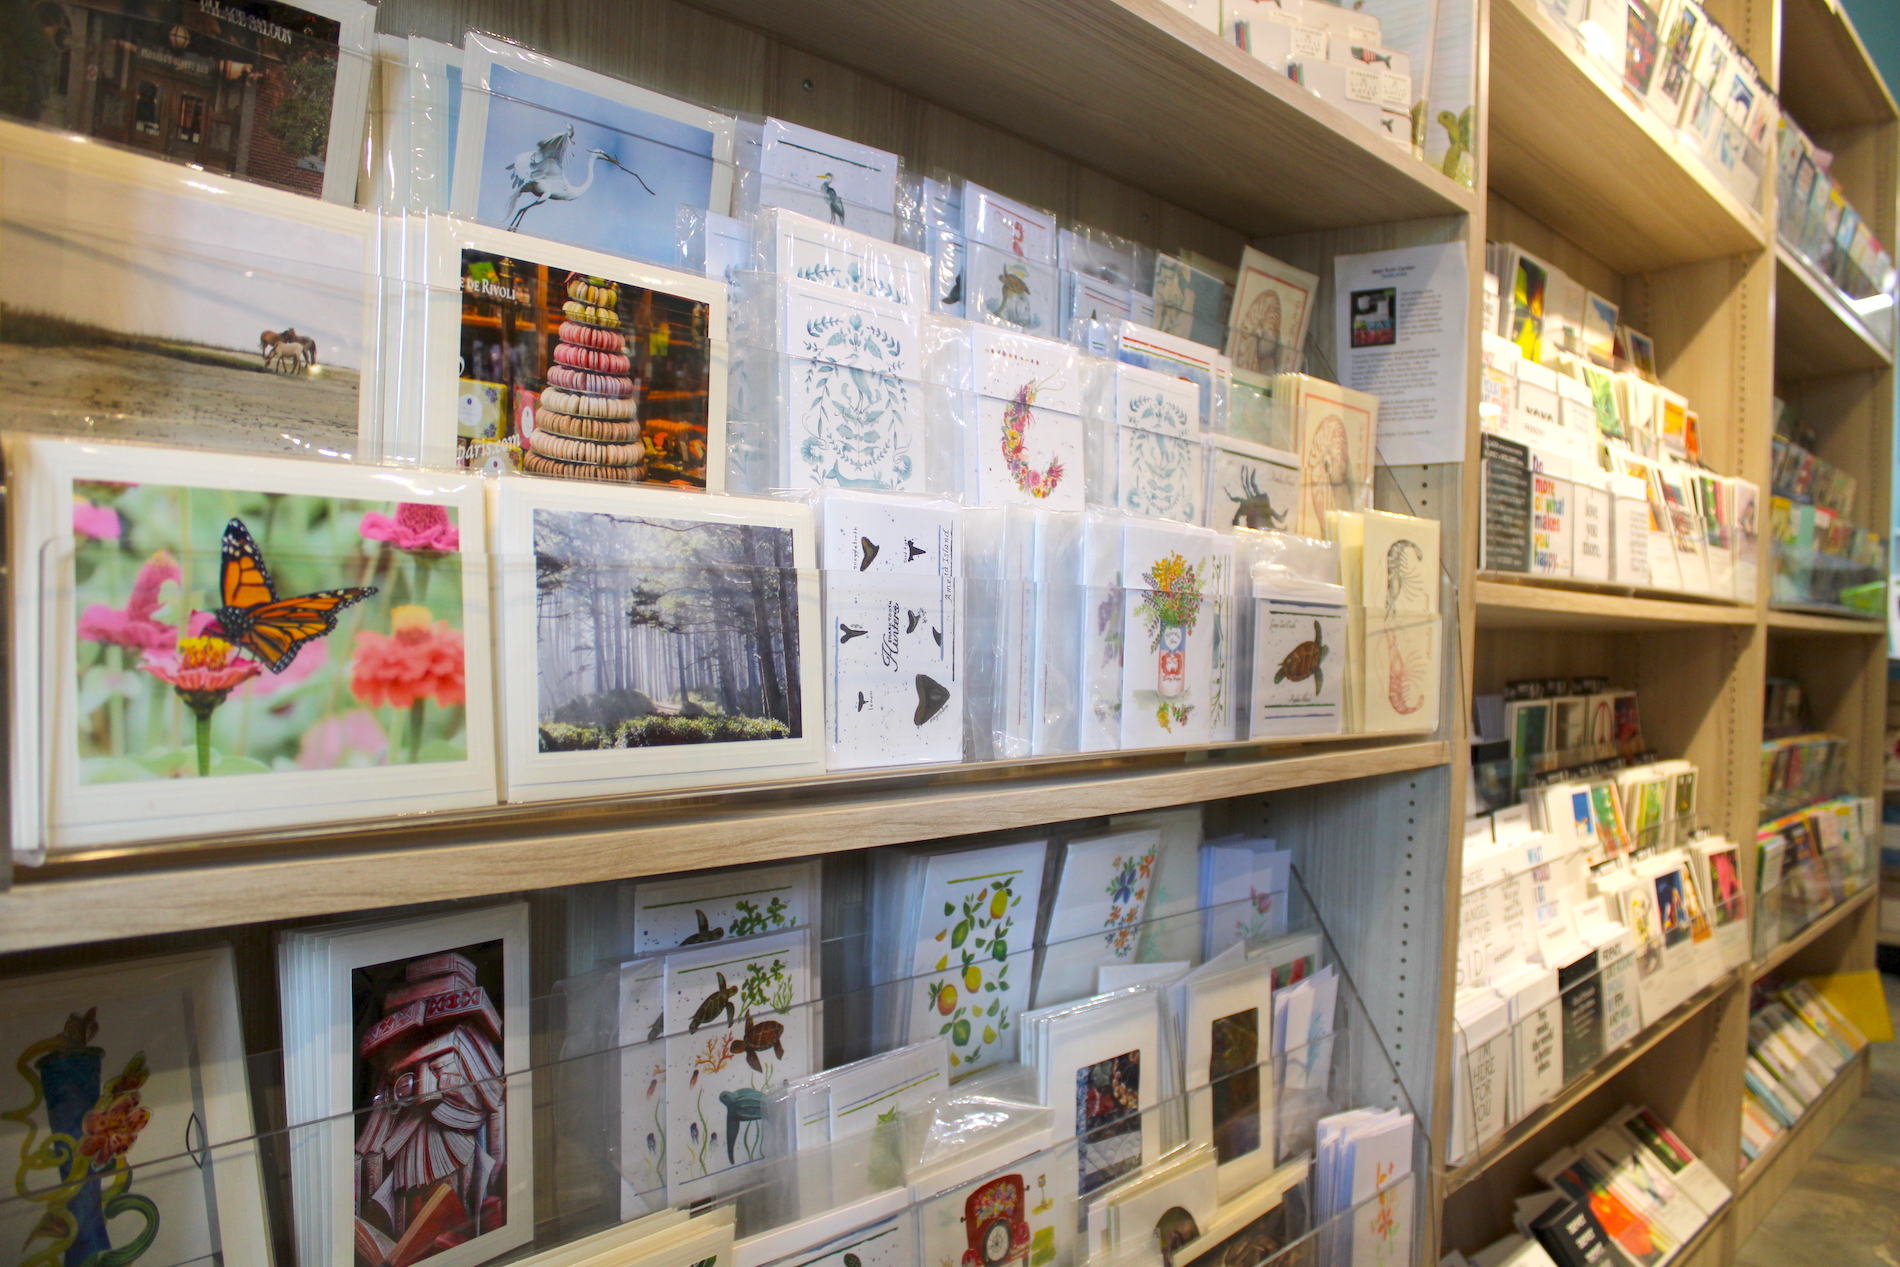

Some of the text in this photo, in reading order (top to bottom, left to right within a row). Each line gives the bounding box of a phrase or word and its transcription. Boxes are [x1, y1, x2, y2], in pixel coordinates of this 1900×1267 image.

[248, 14, 292, 45] SALOON
[482, 278, 517, 300] RIVOLI
[1535, 478, 1555, 496] more
[1535, 496, 1565, 516] of what
[1586, 497, 1598, 519] love
[1535, 514, 1561, 533] makes
[942, 528, 951, 565] Island
[1534, 532, 1550, 552] you
[881, 602, 900, 673] Hunters
[1465, 904, 1490, 924] ANGEL
[1468, 921, 1492, 944] YOUR
[1473, 1056, 1495, 1081] HERE
[1475, 1079, 1492, 1103] FOR
